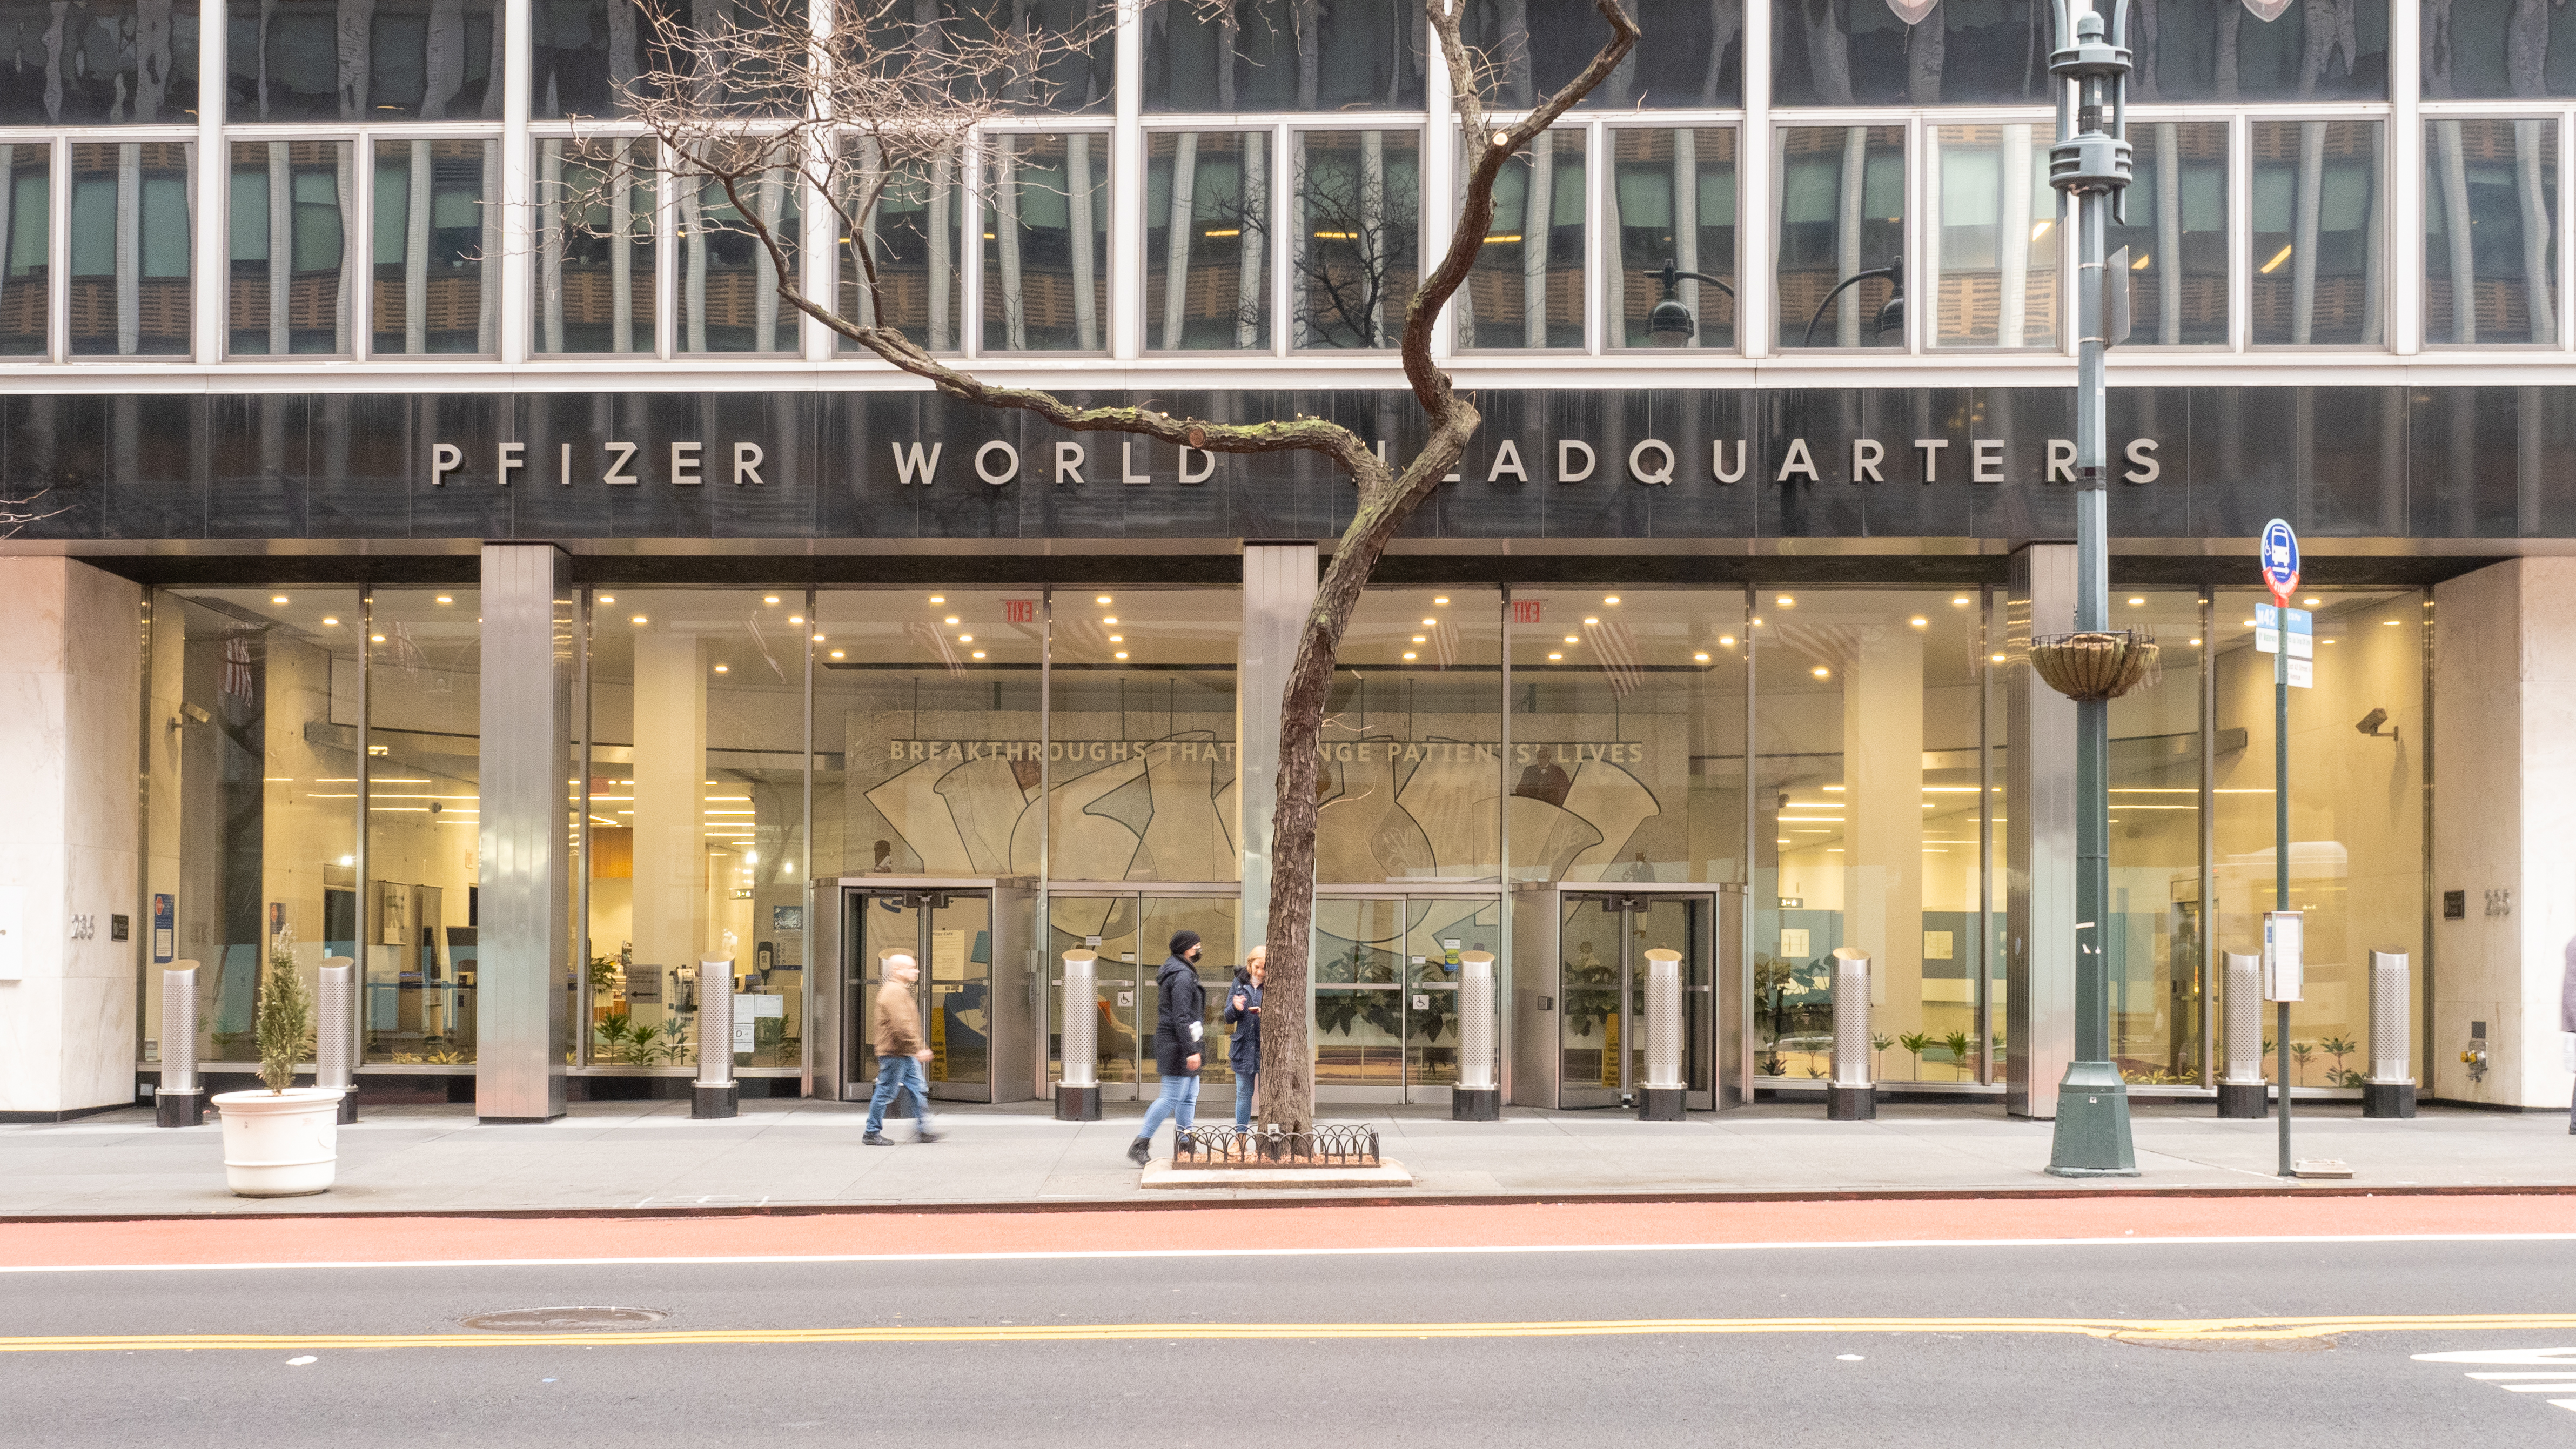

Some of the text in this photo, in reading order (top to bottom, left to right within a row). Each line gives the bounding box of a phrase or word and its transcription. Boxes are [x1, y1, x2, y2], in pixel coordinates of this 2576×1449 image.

[432, 439, 2160, 485] PFIZER WORLD ADQUARTERS
[2257, 608, 2276, 627] M42
[891, 741, 1146, 761] BREAKTHROUGHS
[1161, 742, 1236, 762] THAT
[1557, 743, 1642, 763] LIVES
